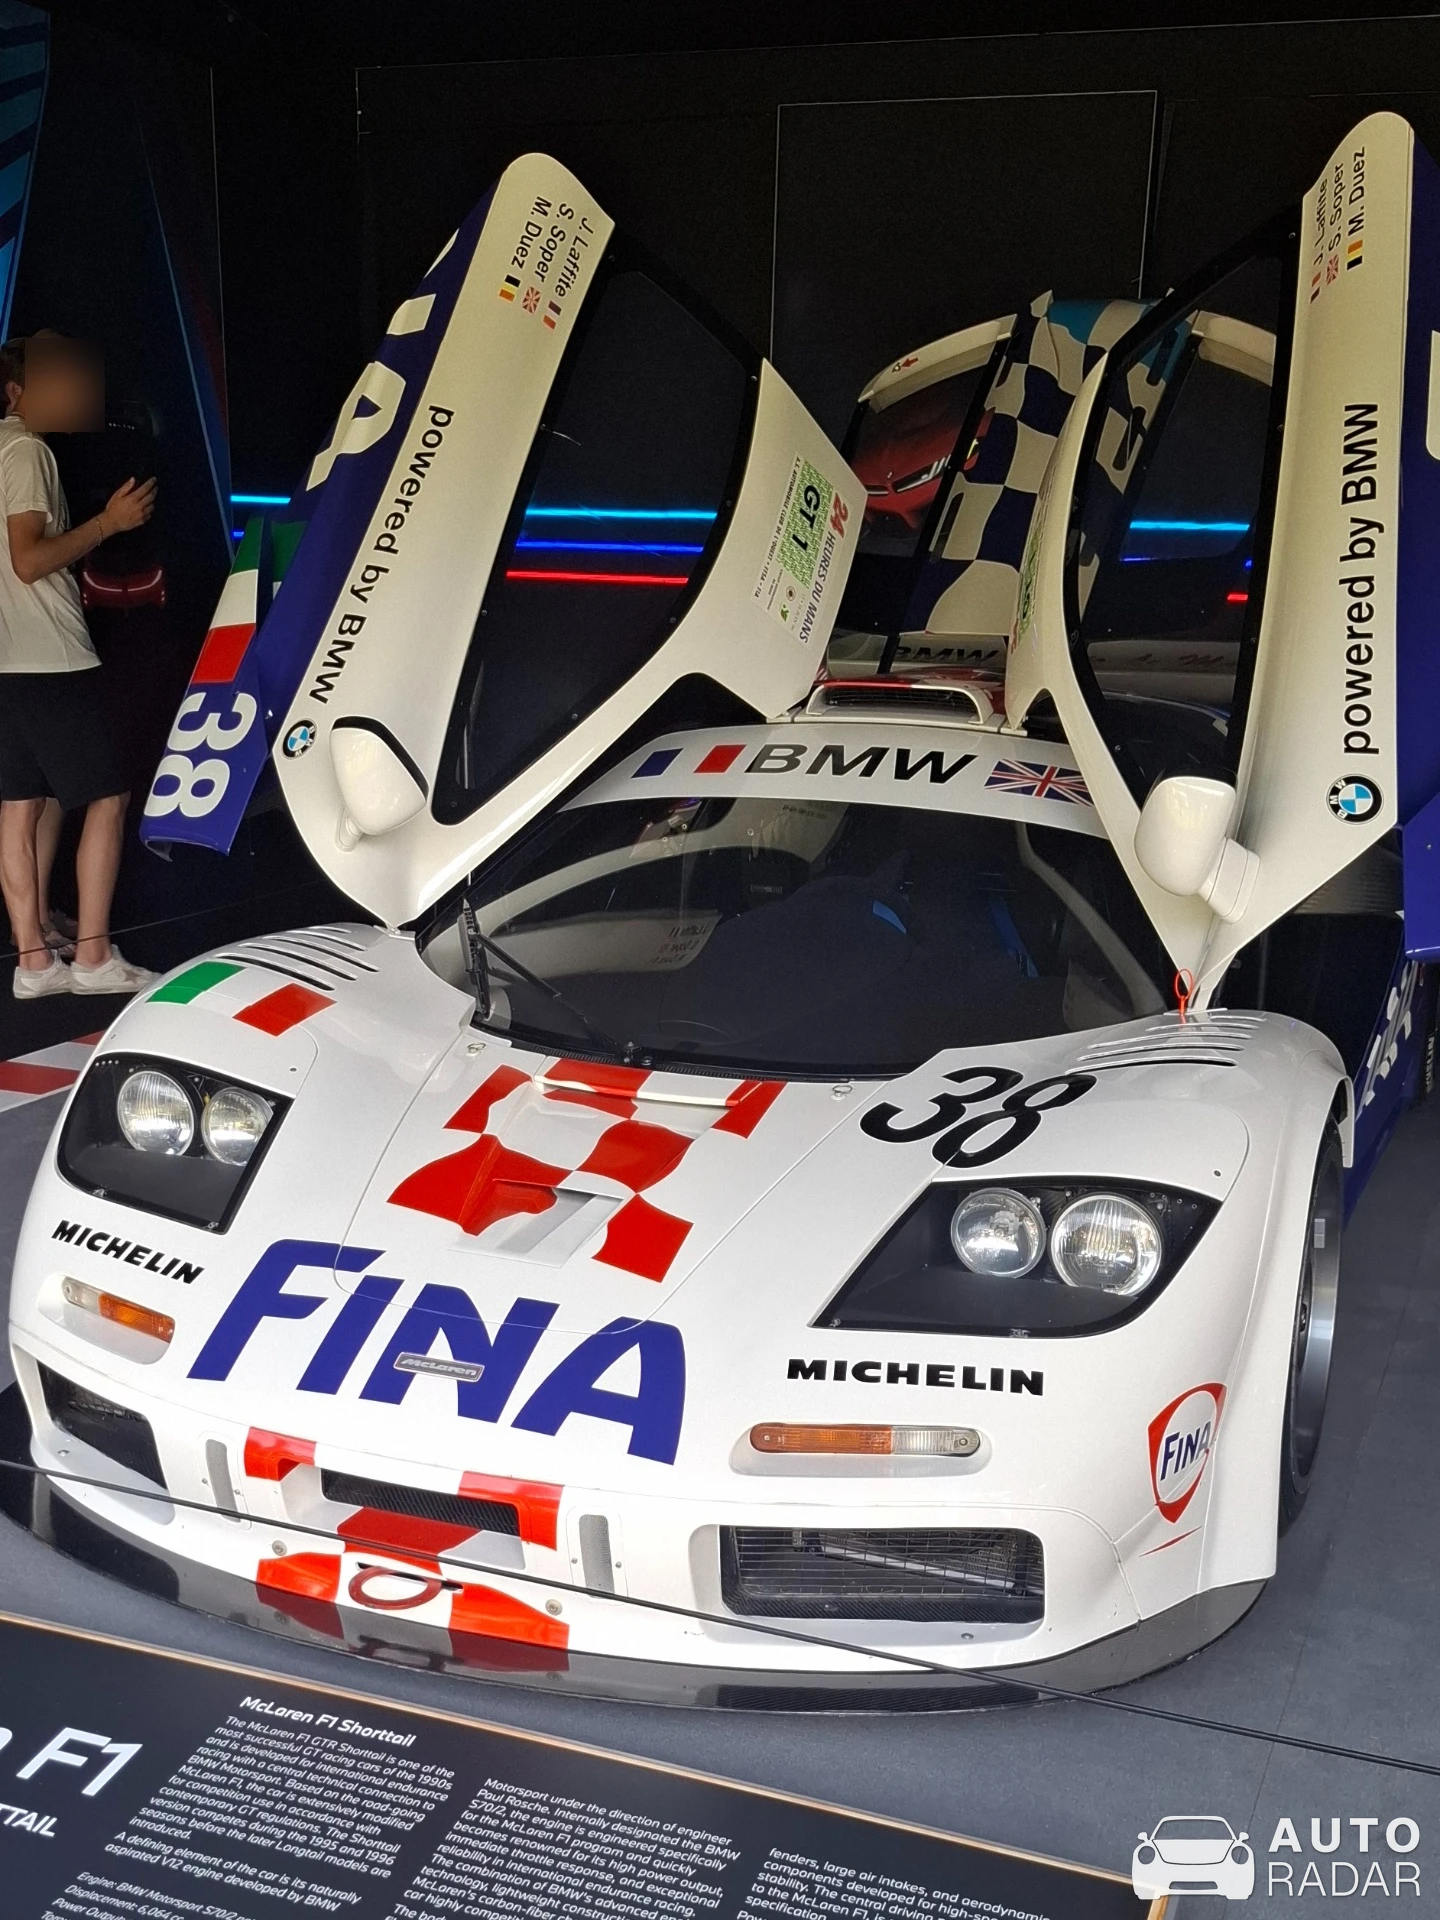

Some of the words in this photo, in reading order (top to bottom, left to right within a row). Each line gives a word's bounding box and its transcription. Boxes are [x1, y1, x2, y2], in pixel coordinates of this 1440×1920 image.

[1329, 163, 1346, 227] Soper
[1349, 146, 1365, 205] Duez
[531, 196, 552, 217] M.
[556, 203, 574, 220] S.
[578, 217, 594, 234] J.
[1348, 205, 1365, 236] M.
[511, 221, 543, 269] Duez
[534, 225, 566, 283] Soper
[555, 235, 589, 297] Laffite
[1328, 226, 1341, 252] S.
[372, 405, 454, 554] powered
[1341, 403, 1379, 506] BMW
[800, 485, 820, 529] GT
[830, 493, 849, 539] 24
[792, 533, 808, 552] 1
[817, 531, 836, 582] HEURES
[1340, 517, 1384, 563] by
[349, 563, 390, 604] by
[811, 582, 823, 603] DU
[800, 603, 817, 643] MANS
[309, 614, 367, 703] BMW
[1339, 575, 1380, 755] powered
[143, 692, 258, 818] 38
[745, 744, 979, 785] BMW
[859, 1066, 1097, 1168] 38
[52, 1220, 204, 1284] MICHELIN
[186, 1238, 687, 1466] FINA
[401, 1358, 477, 1376] McLaren
[787, 1358, 1044, 1396] MICHELIN
[1160, 1421, 1211, 1481] FINA
[225, 1715, 246, 1727] The
[246, 1720, 295, 1739] McLaren
[295, 1732, 311, 1743] F1
[310, 1736, 338, 1749] GTR
[336, 1742, 386, 1761] Shorttail
[385, 1754, 397, 1764] is
[397, 1758, 420, 1770] one
[421, 1764, 437, 1773] of
[434, 1766, 454, 1778] the
[239, 1696, 315, 1724] McLaren
[316, 1713, 339, 1729] F1
[337, 1719, 417, 1748] Shorttail
[16, 1727, 143, 1796] F1
[187, 1754, 221, 1769] BMW
[218, 1761, 282, 1785] Motorsport.
[284, 1778, 324, 1794] Based
[322, 1789, 339, 1799] on
[340, 1792, 360, 1804] the
[360, 1799, 425, 1822] road-going
[195, 1746, 231, 1761] racing
[231, 1754, 256, 1766] with
[266, 1763, 307, 1778] central
[305, 1771, 359, 1791] technical
[357, 1785, 421, 1807] connection
[421, 1800, 435, 1810] to
[205, 1736, 230, 1747] and
[228, 1740, 240, 1749] is
[240, 1743, 300, 1764] developed
[297, 1757, 316, 1767] for
[314, 1761, 388, 1785] international
[386, 1780, 448, 1801] endurance
[214, 1726, 244, 1739] most
[243, 1733, 303, 1752] successful
[302, 1746, 323, 1757] GT
[320, 1752, 356, 1767] racing
[356, 1761, 382, 1772] cars
[382, 1767, 398, 1775] of
[395, 1769, 415, 1781] the
[417, 1773, 453, 1790] 1990s
[158, 1786, 237, 1812] contemporary
[237, 1804, 259, 1815] GT
[255, 1810, 321, 1834] regulations.
[325, 1826, 348, 1840] The
[348, 1832, 401, 1853] Shorttail
[167, 1774, 186, 1785] for
[185, 1780, 251, 1802] competition
[251, 1796, 274, 1808] use
[274, 1800, 287, 1811] in
[287, 1806, 354, 1828] accordance
[355, 1823, 381, 1835] with
[177, 1764, 227, 1783] McLaren
[227, 1776, 244, 1789] F1,
[245, 1781, 265, 1793] the
[265, 1787, 286, 1797] car
[284, 1790, 297, 1801] is
[297, 1795, 362, 1818] extensively
[361, 1812, 415, 1830] modified
[476, 1788, 505, 1802] Paul
[504, 1795, 550, 1814] Rosche.
[553, 1807, 610, 1829] Internally
[610, 1822, 680, 1845] designated
[680, 1838, 702, 1851] the
[703, 1844, 741, 1860] BMW
[483, 1777, 549, 1801] Motorsport
[549, 1795, 586, 1809] under
[586, 1803, 606, 1815] the
[608, 1809, 660, 1828] direction
[662, 1823, 677, 1831] of
[676, 1826, 732, 1845] engineer
[452, 1820, 508, 1841] becomes
[509, 1836, 572, 1857] renowned
[571, 1850, 591, 1861] for
[590, 1854, 606, 1866] its
[607, 1858, 636, 1874] high
[636, 1868, 679, 1884] power
[679, 1878, 723, 1898] output,
[460, 1809, 479, 1821] for
[478, 1814, 499, 1826] the
[500, 1819, 554, 1840] McLaren
[555, 1832, 571, 1844] F1
[569, 1838, 623, 1857] program
[625, 1852, 652, 1864] and
[652, 1858, 696, 1877] quickly
[468, 1798, 506, 1817] S70/2,
[509, 1809, 530, 1821] the
[531, 1816, 573, 1832] engine
[574, 1824, 586, 1835] is
[587, 1829, 657, 1852] engineered
[657, 1847, 727, 1871] specifically
[76, 1871, 117, 1888] Engine:
[115, 1881, 149, 1896] BMW
[144, 1889, 204, 1912] Motorsport
[763, 1860, 843, 1887] components
[846, 1881, 915, 1905] developed
[916, 1897, 937, 1910] for
[768, 1848, 819, 1870] fenders,
[823, 1861, 856, 1877] large
[858, 1871, 877, 1882] air
[877, 1874, 928, 1897] intakes,
[931, 1890, 959, 1903] and
